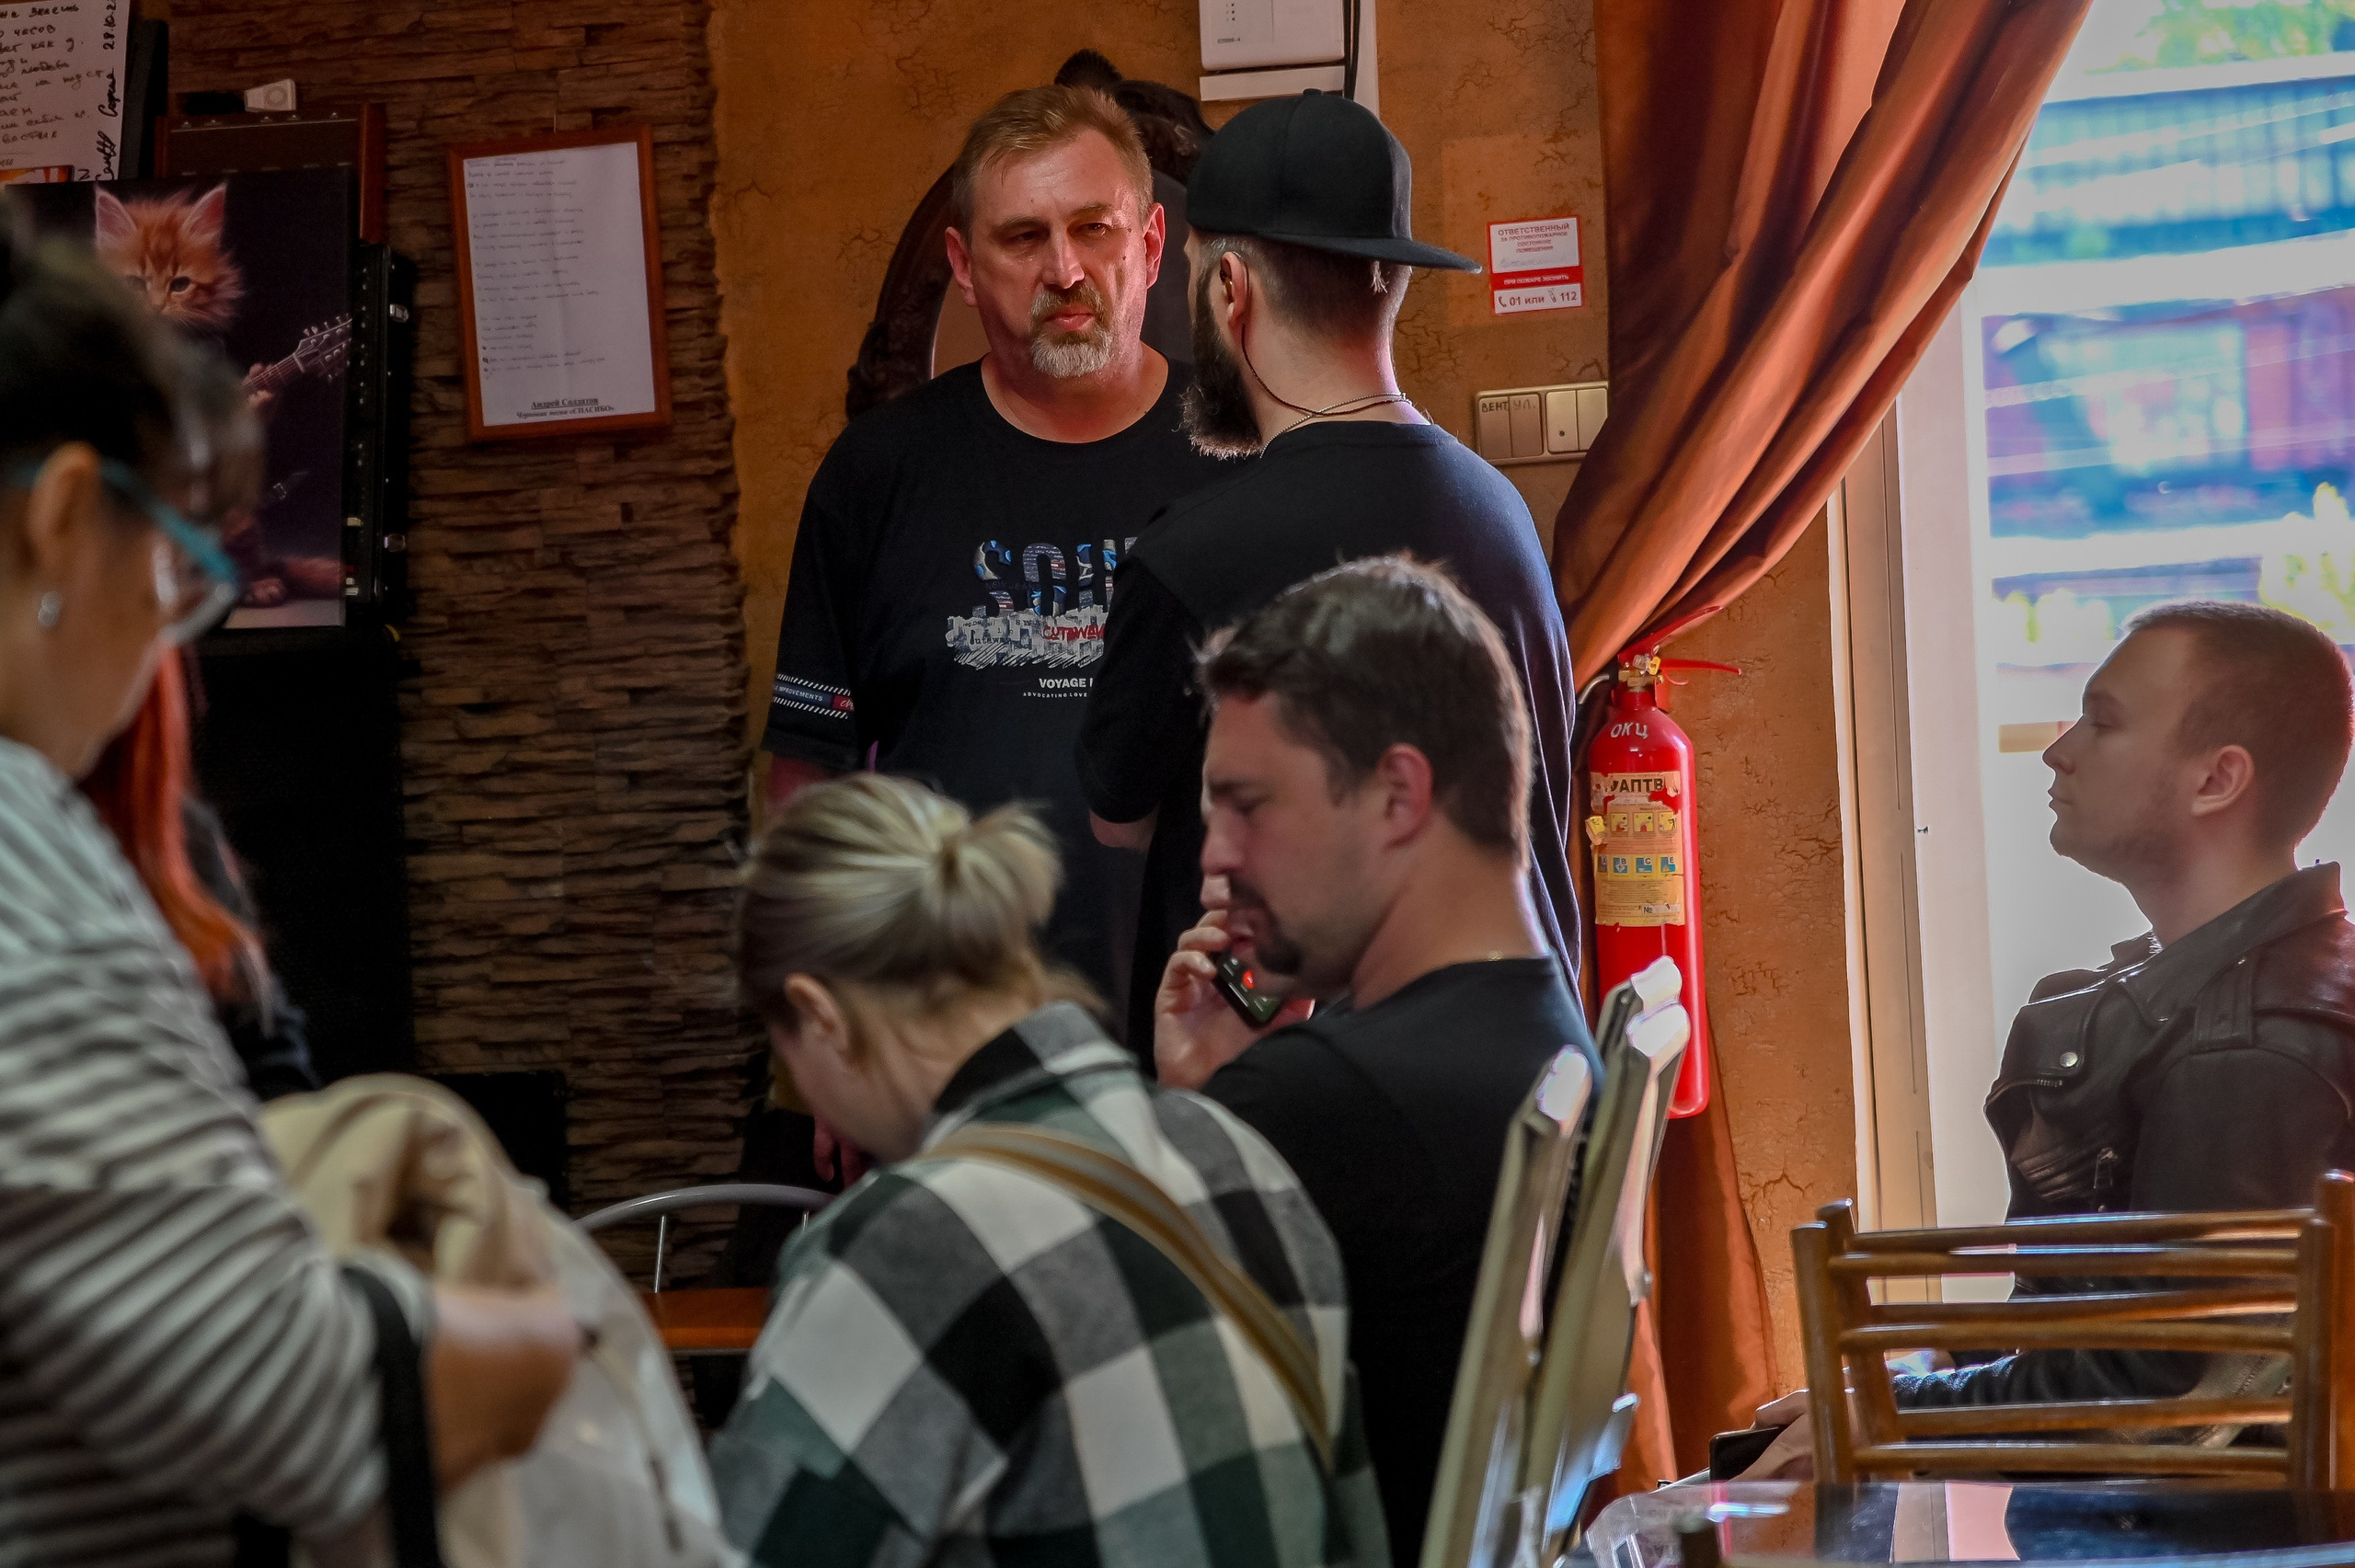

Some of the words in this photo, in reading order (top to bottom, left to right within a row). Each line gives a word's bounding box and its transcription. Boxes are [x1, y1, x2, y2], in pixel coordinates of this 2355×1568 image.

[1498, 223, 1569, 236] ОТВЕТСТВЕННЫЙ
[1509, 296, 1522, 306] 01
[1524, 296, 1545, 304] или
[1559, 291, 1578, 302] 112
[1039, 678, 1086, 689] VOYAGE
